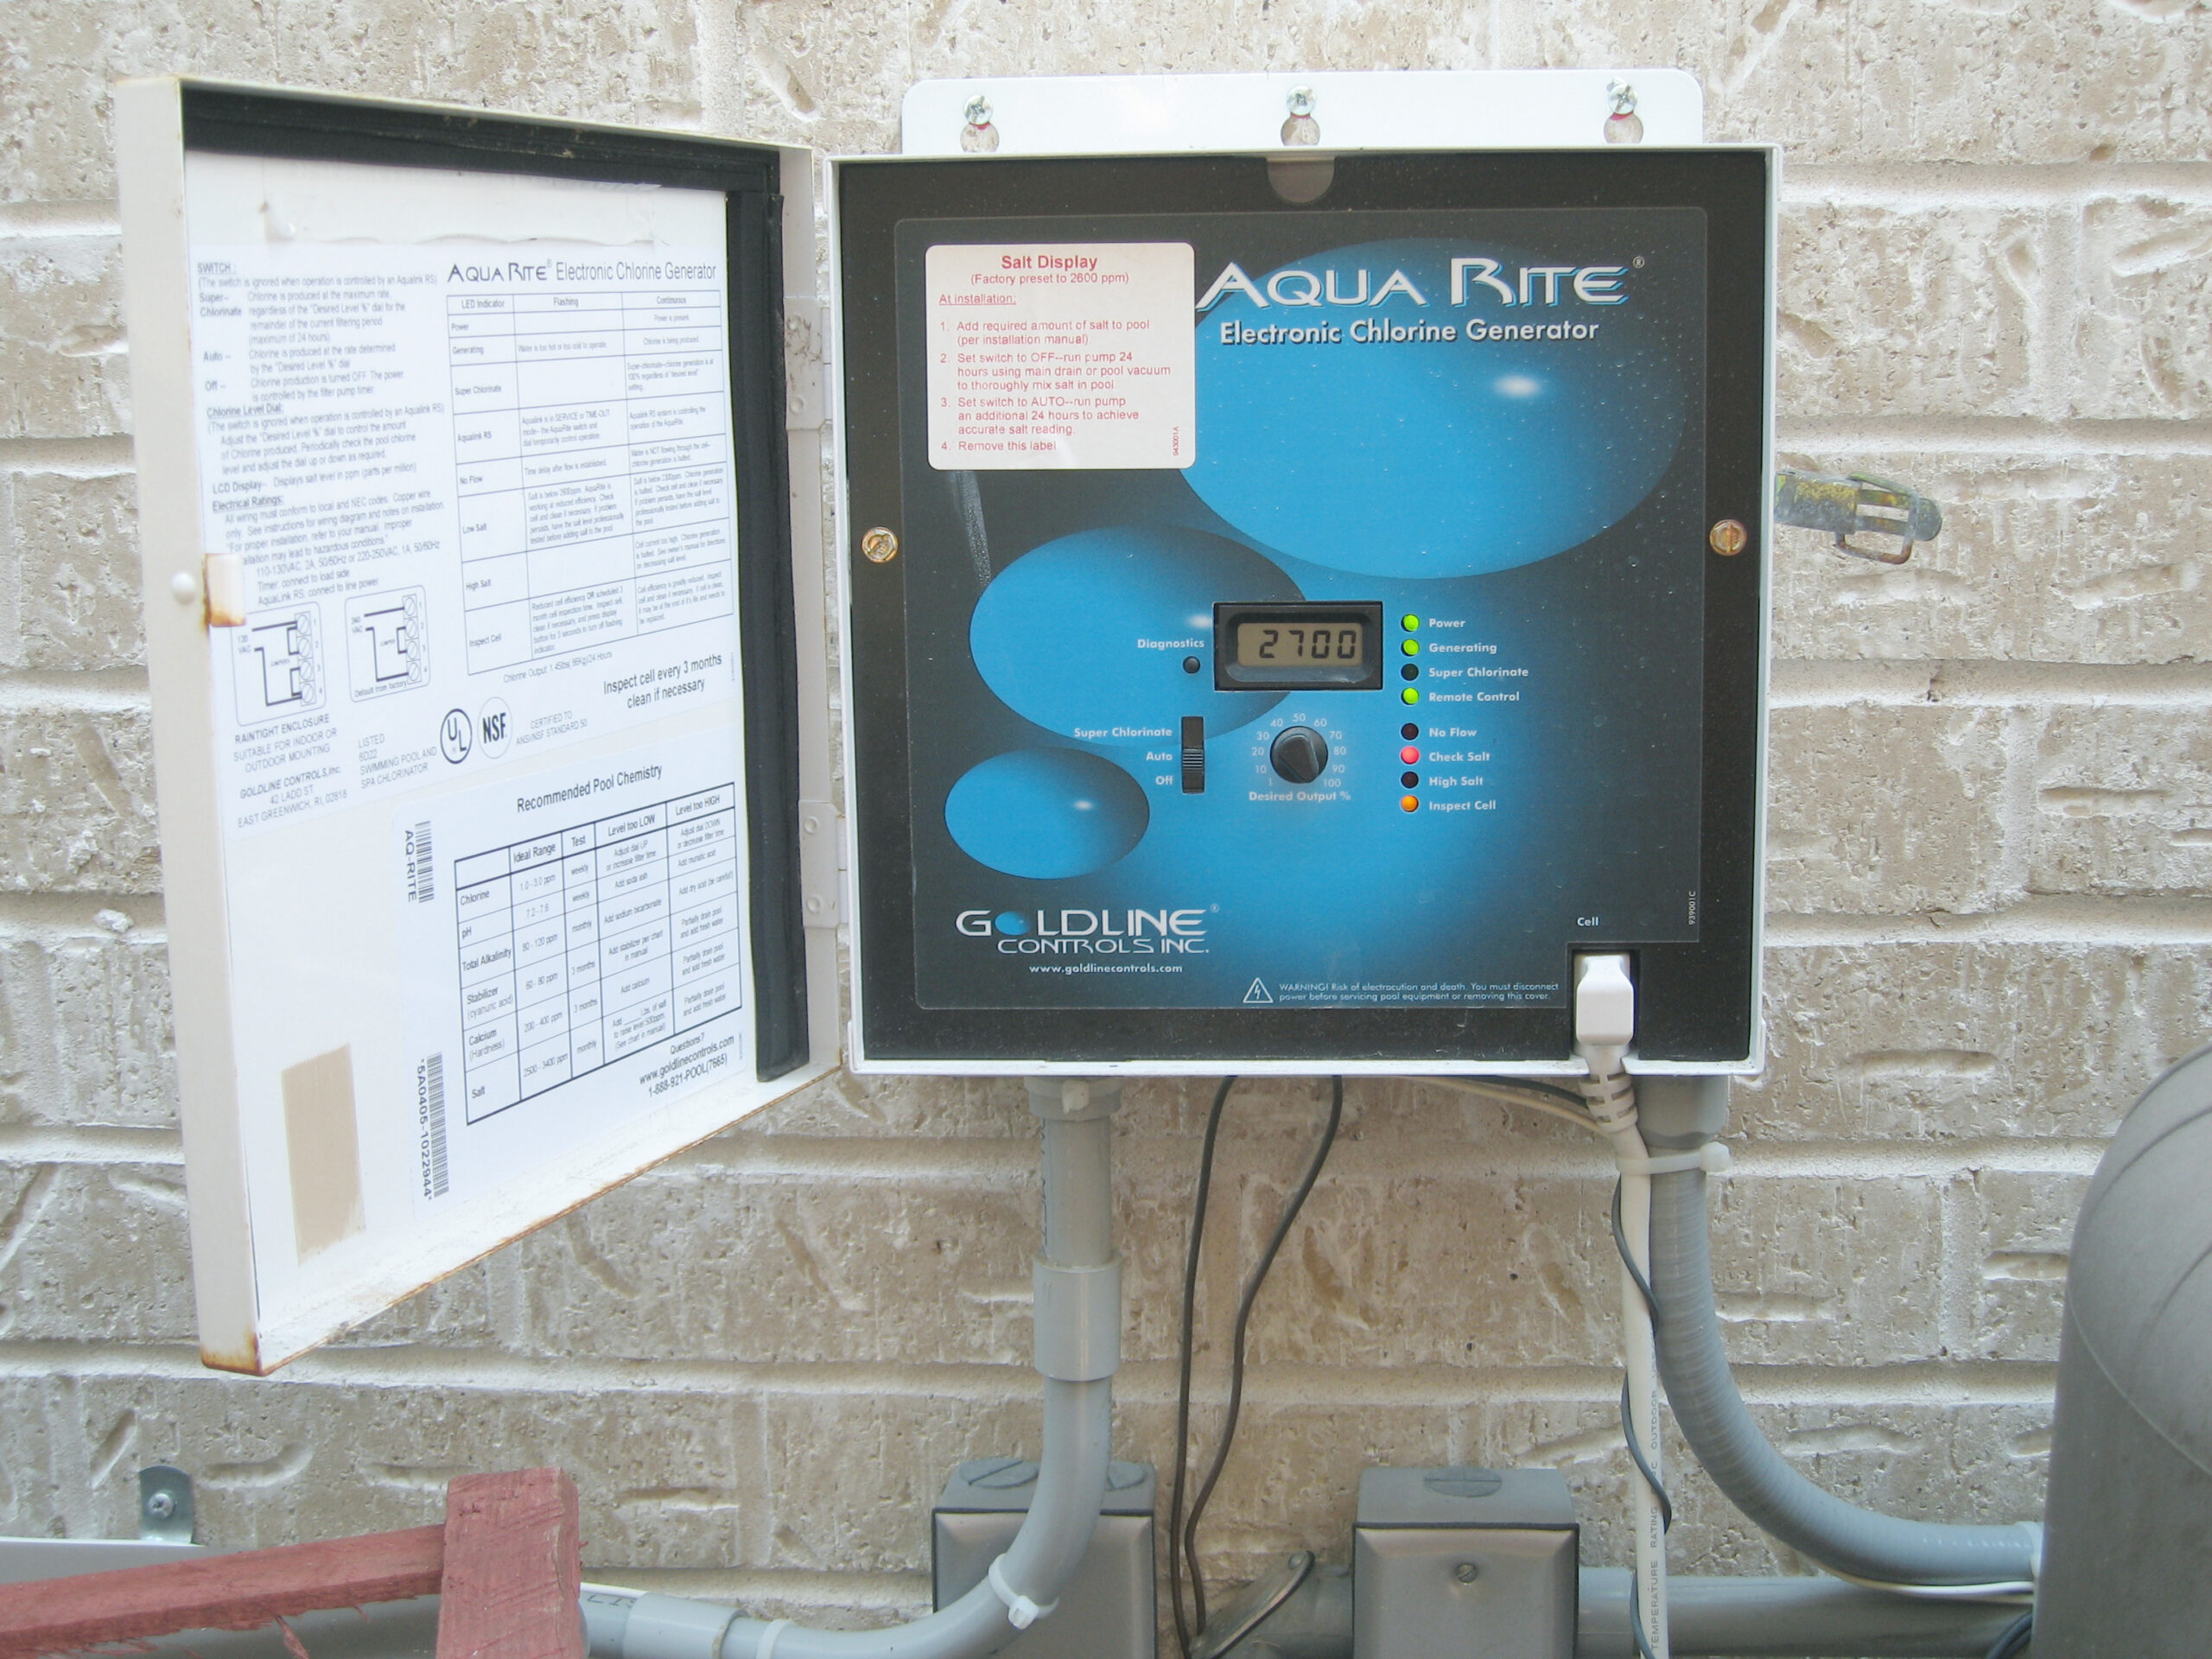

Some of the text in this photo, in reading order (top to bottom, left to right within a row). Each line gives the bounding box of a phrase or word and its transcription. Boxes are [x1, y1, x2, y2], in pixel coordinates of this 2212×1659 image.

[1001, 256, 1097, 270] Salt Display
[448, 262, 715, 283] AQUA RITE Electronic Chlorine Generator
[971, 274, 1015, 286] (Factory
[1020, 275, 1053, 285] preset
[1071, 273, 1097, 283] 2600
[1102, 273, 1128, 283] ppm)
[1195, 257, 1630, 312] AQUA RITE
[939, 294, 1016, 304] At installation:
[941, 320, 1150, 333] 1. Add required amount of salt to pool
[1220, 319, 1599, 344] Electronic Chlorine Generator
[957, 336, 979, 346] (per
[983, 335, 1040, 345] installation
[940, 353, 950, 363] 2.
[957, 353, 976, 363] Set
[980, 353, 1013, 362] switch
[1017, 353, 1027, 362] to
[1085, 353, 1116, 365] pump
[1119, 353, 1133, 361] 24
[957, 365, 1171, 378] hours using main drain or pool vacuum
[957, 381, 968, 390] to
[971, 380, 1028, 392] thoroughly
[1033, 380, 1051, 390] mix
[1055, 379, 1073, 390] salt
[1077, 379, 1087, 389] in
[941, 397, 950, 407] 3.
[958, 397, 976, 407] Set
[980, 397, 1014, 407] switch
[1017, 397, 1027, 407] to
[1095, 398, 1126, 409] pump
[976, 410, 1028, 420] additional
[1032, 410, 1045, 420] 24
[1048, 410, 1079, 420] hours
[1083, 410, 1093, 420] to
[1097, 410, 1139, 420] achieve
[958, 425, 1005, 435] accurate
[1009, 424, 1027, 435] salt
[958, 442, 1004, 450] Remove
[1007, 441, 1027, 450] this
[1030, 441, 1057, 450] label
[1429, 619, 1465, 628] Power
[1137, 639, 1205, 650] Diagnostics
[1260, 630, 1357, 659] 2700
[1429, 643, 1497, 654] Generating
[604, 676, 638, 696] Inspect
[640, 670, 655, 685] cell
[658, 664, 681, 682] every
[683, 661, 689, 674] 3
[691, 653, 721, 672] months
[1429, 667, 1529, 678] Super Chlorinate
[627, 677, 705, 709] clean if necessary
[1429, 691, 1520, 702] Remote Control
[1271, 718, 1282, 728] 40
[1293, 713, 1306, 722] 50
[1314, 718, 1326, 727] 60
[483, 713, 507, 744] NSF
[1074, 728, 1173, 739] Super Chlorinate
[1429, 728, 1477, 737] No Flow
[1329, 731, 1342, 740] 70
[1146, 752, 1173, 761] Auto
[1252, 747, 1264, 756] 20
[1333, 747, 1346, 755] 80
[1429, 753, 1490, 762] Check Salt
[1255, 765, 1267, 774] 10
[1332, 765, 1345, 774] 90
[1156, 776, 1173, 785] Off
[1323, 779, 1340, 787] 100
[1429, 777, 1484, 788] High Salt
[518, 765, 662, 813] Recommended Pool Chemistry
[1249, 791, 1351, 803] Desired Output %
[1429, 801, 1496, 812] Inspect Cell
[513, 843, 556, 864] Ideal Range
[405, 830, 416, 903] AQ-RITE
[956, 909, 1207, 937] GOLDLINE
[1577, 917, 1599, 926] Cell
[998, 939, 1209, 954] CONTROLS INC.
[1029, 963, 1182, 975] www.goldlinecontrols.com
[1340, 992, 1377, 1001] servicing
[1380, 992, 1400, 1001] pool
[1402, 993, 1449, 1001] equipment
[1464, 992, 1504, 1001] removing
[1649, 1505, 1658, 1548] RATING
[1649, 1560, 1659, 1651] TEMPERATURE
